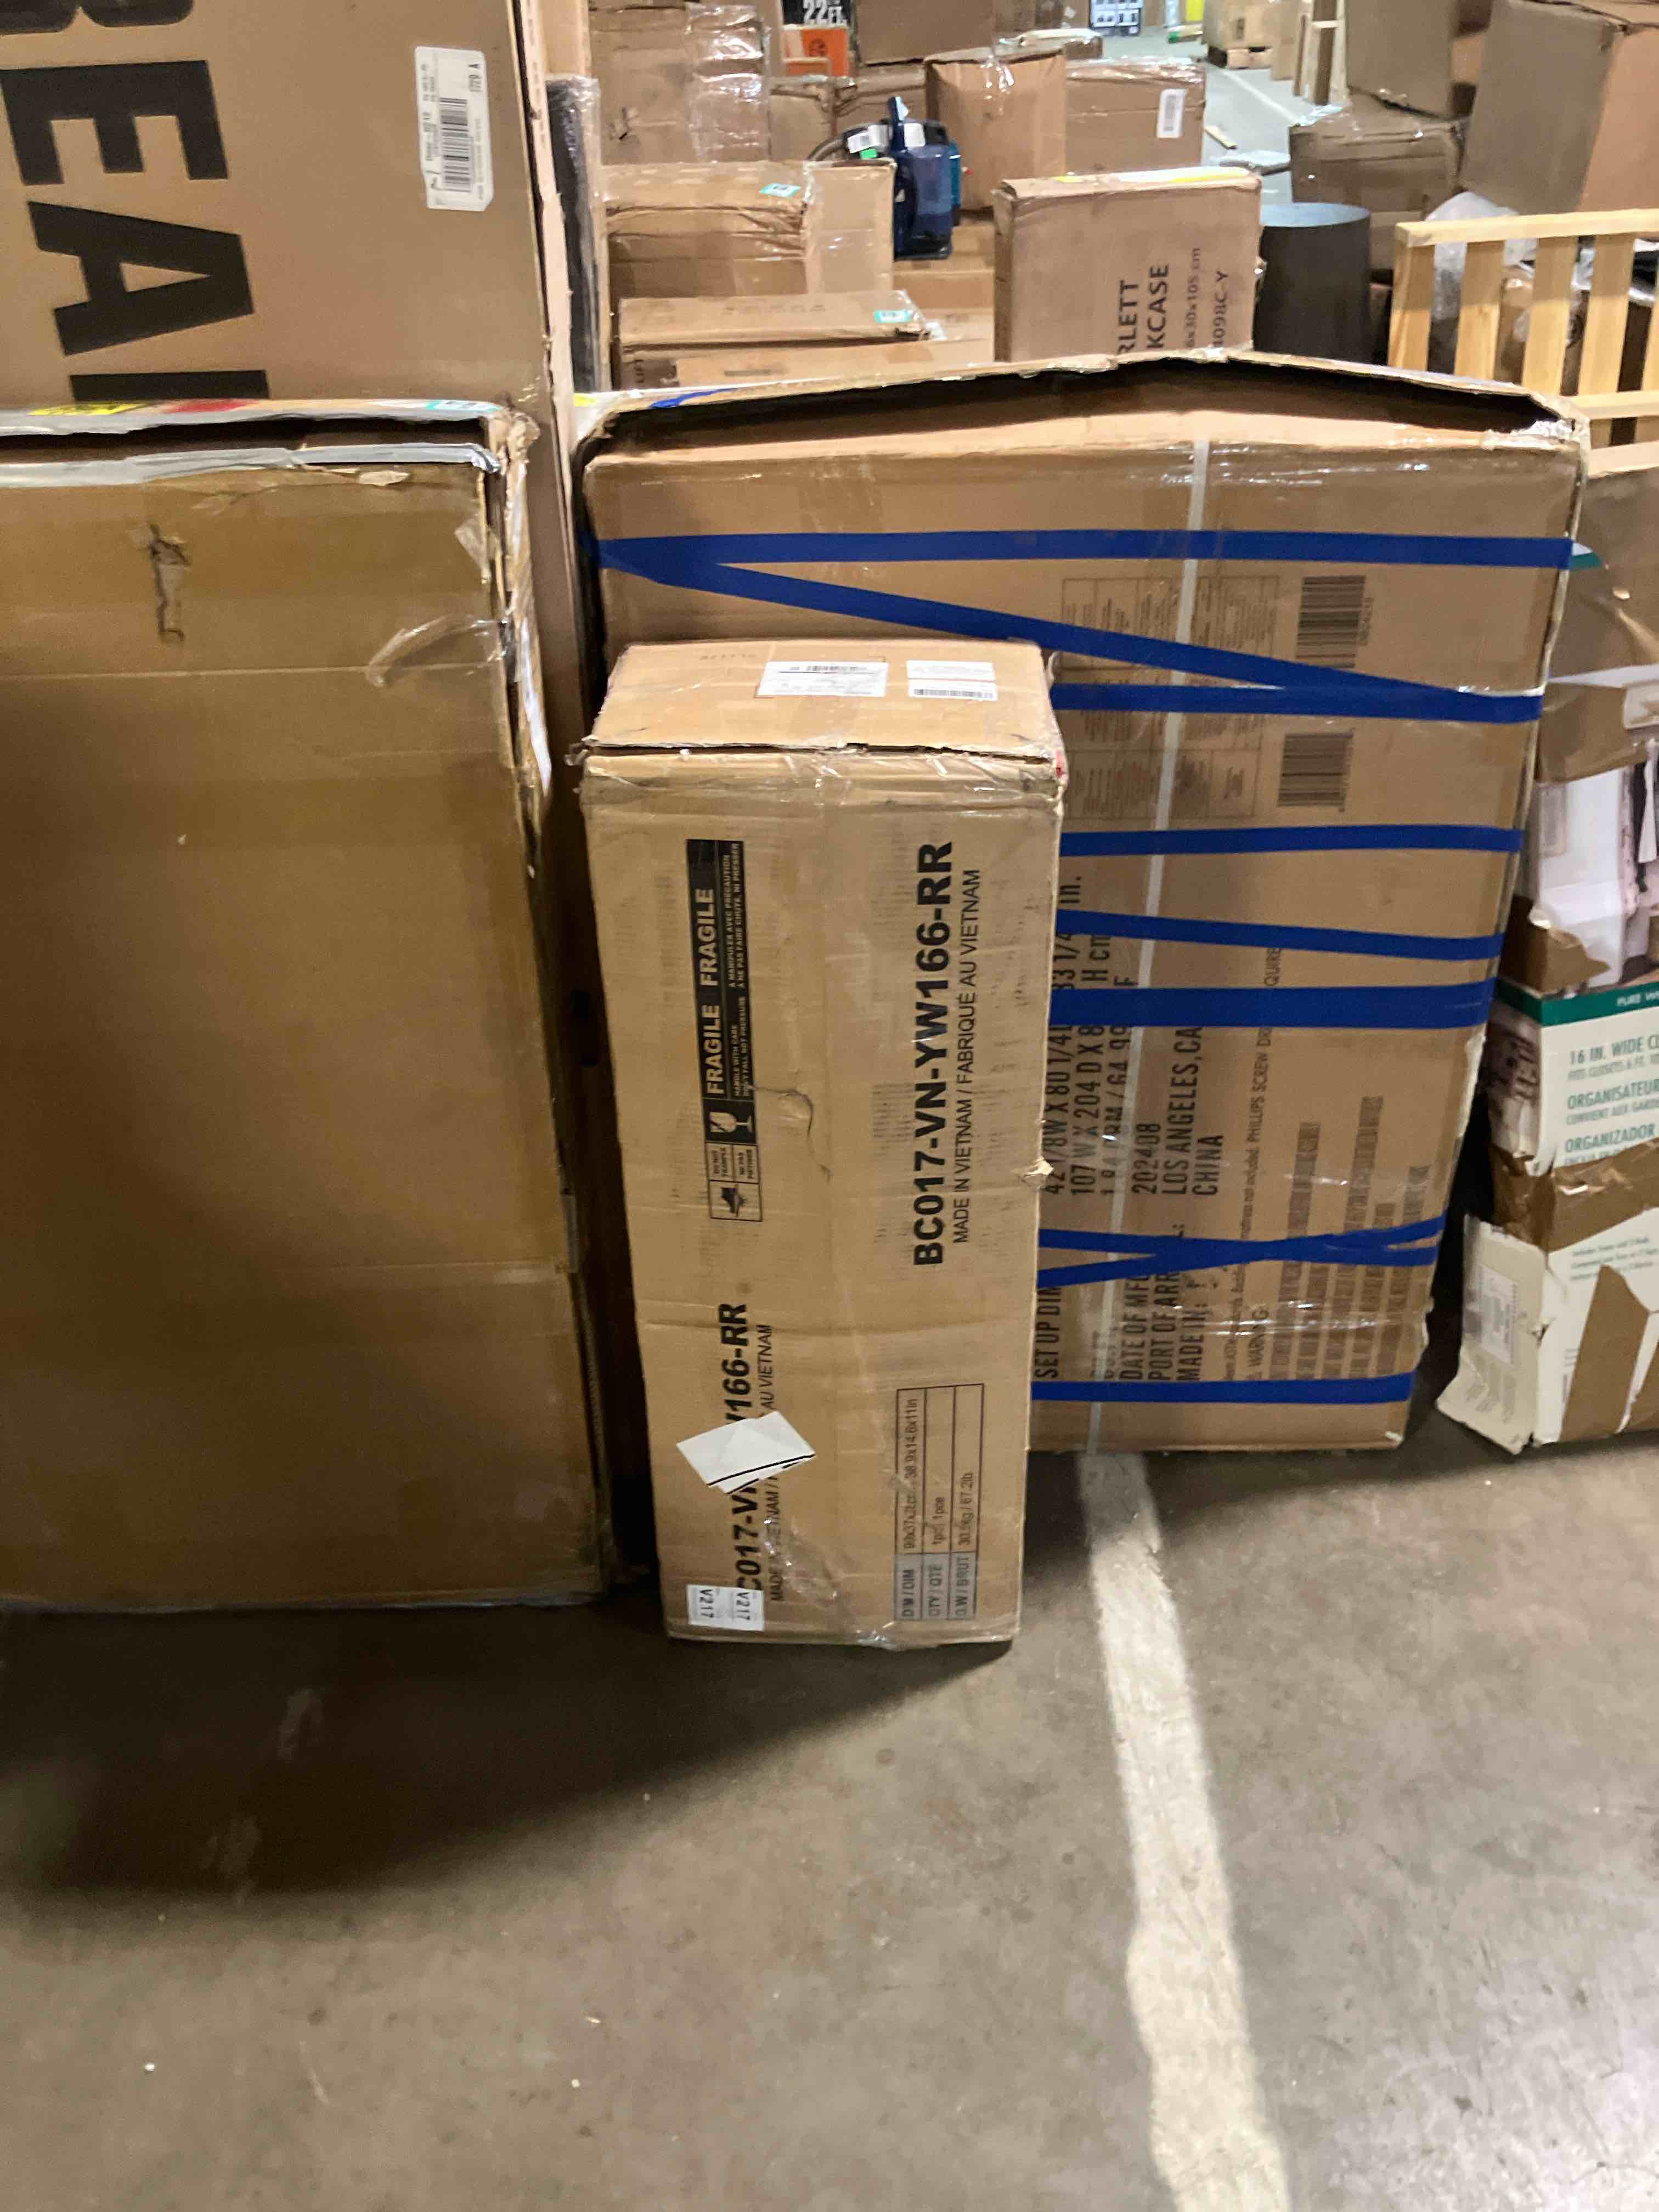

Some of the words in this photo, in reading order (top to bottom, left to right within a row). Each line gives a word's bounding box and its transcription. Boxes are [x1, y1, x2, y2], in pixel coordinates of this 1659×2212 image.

[0, 0, 271, 400] EA
[1146, 264, 1169, 349] KCASE
[959, 870, 979, 956] VIETNAM
[695, 889, 719, 986] FRAGILE
[958, 961, 977, 987] AU
[1081, 970, 1109, 981] H
[702, 1005, 725, 1094] FRAGILE
[955, 992, 975, 1084] FABRIQUÉ
[1077, 1044, 1104, 1055] X
[1571, 1050, 1585, 1065] 16
[1589, 1046, 1606, 1062] IN.
[1611, 1037, 1642, 1058] WIDE
[913, 842, 952, 1266] BC017-VN-YW166-RR
[1076, 1062, 1102, 1073] D
[1045, 1071, 1070, 1095] 80
[1251, 1051, 1269, 1092] SCREW
[1074, 1081, 1101, 1119] 204
[1073, 1126, 1099, 1136] X
[1246, 1097, 1266, 1143] PHILLIPS
[954, 1099, 973, 1174] VIETNAM
[1071, 1142, 1097, 1158] W
[1565, 1123, 1655, 1153] ORGANIZADOR
[1131, 1124, 1161, 1194] 202408
[1192, 1135, 1224, 1196] CHINA
[954, 1176, 970, 1192] IN
[1070, 1165, 1096, 1195] 107
[1161, 1159, 1189, 1194] LOS
[953, 1198, 971, 1244] MADE
[1035, 1322, 1060, 1345] UP
[1122, 1314, 1147, 1334] OF
[1151, 1312, 1176, 1333] OF
[755, 1325, 774, 1387] VIETNAM
[1035, 1350, 1058, 1379] SET
[1120, 1340, 1145, 1380] DATE
[1148, 1339, 1173, 1380] PORT
[1176, 1335, 1204, 1381] MADE
[760, 1390, 775, 1410] AU
[902, 1570, 915, 1589] DIM
[956, 1557, 970, 1587] BRUT
[699, 1589, 715, 1618] V217
[736, 1592, 751, 1621] V217
